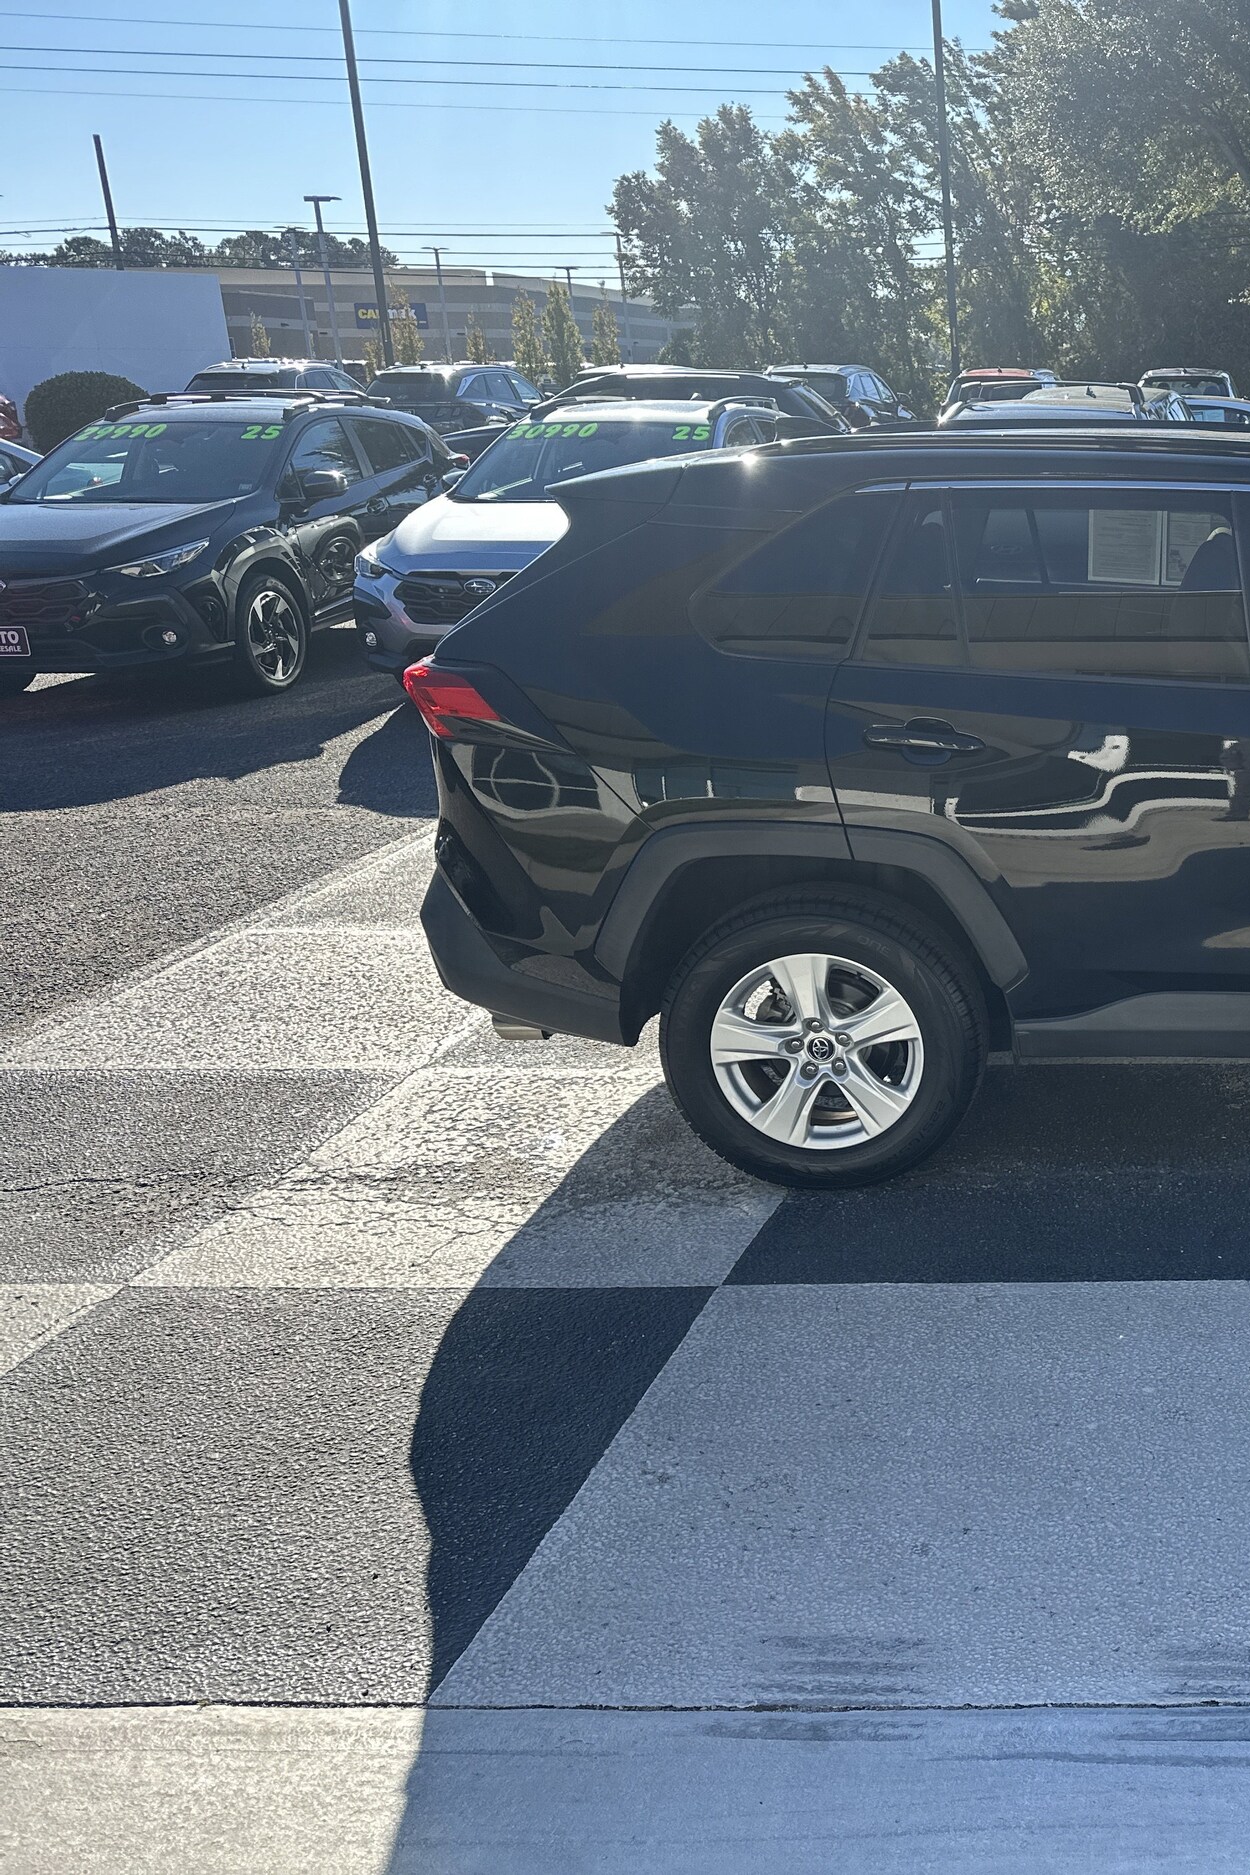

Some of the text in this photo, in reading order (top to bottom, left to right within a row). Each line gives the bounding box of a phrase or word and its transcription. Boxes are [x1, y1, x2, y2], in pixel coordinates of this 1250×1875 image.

[73, 423, 284, 441] 29990 25
[505, 422, 711, 441] 30990 25
